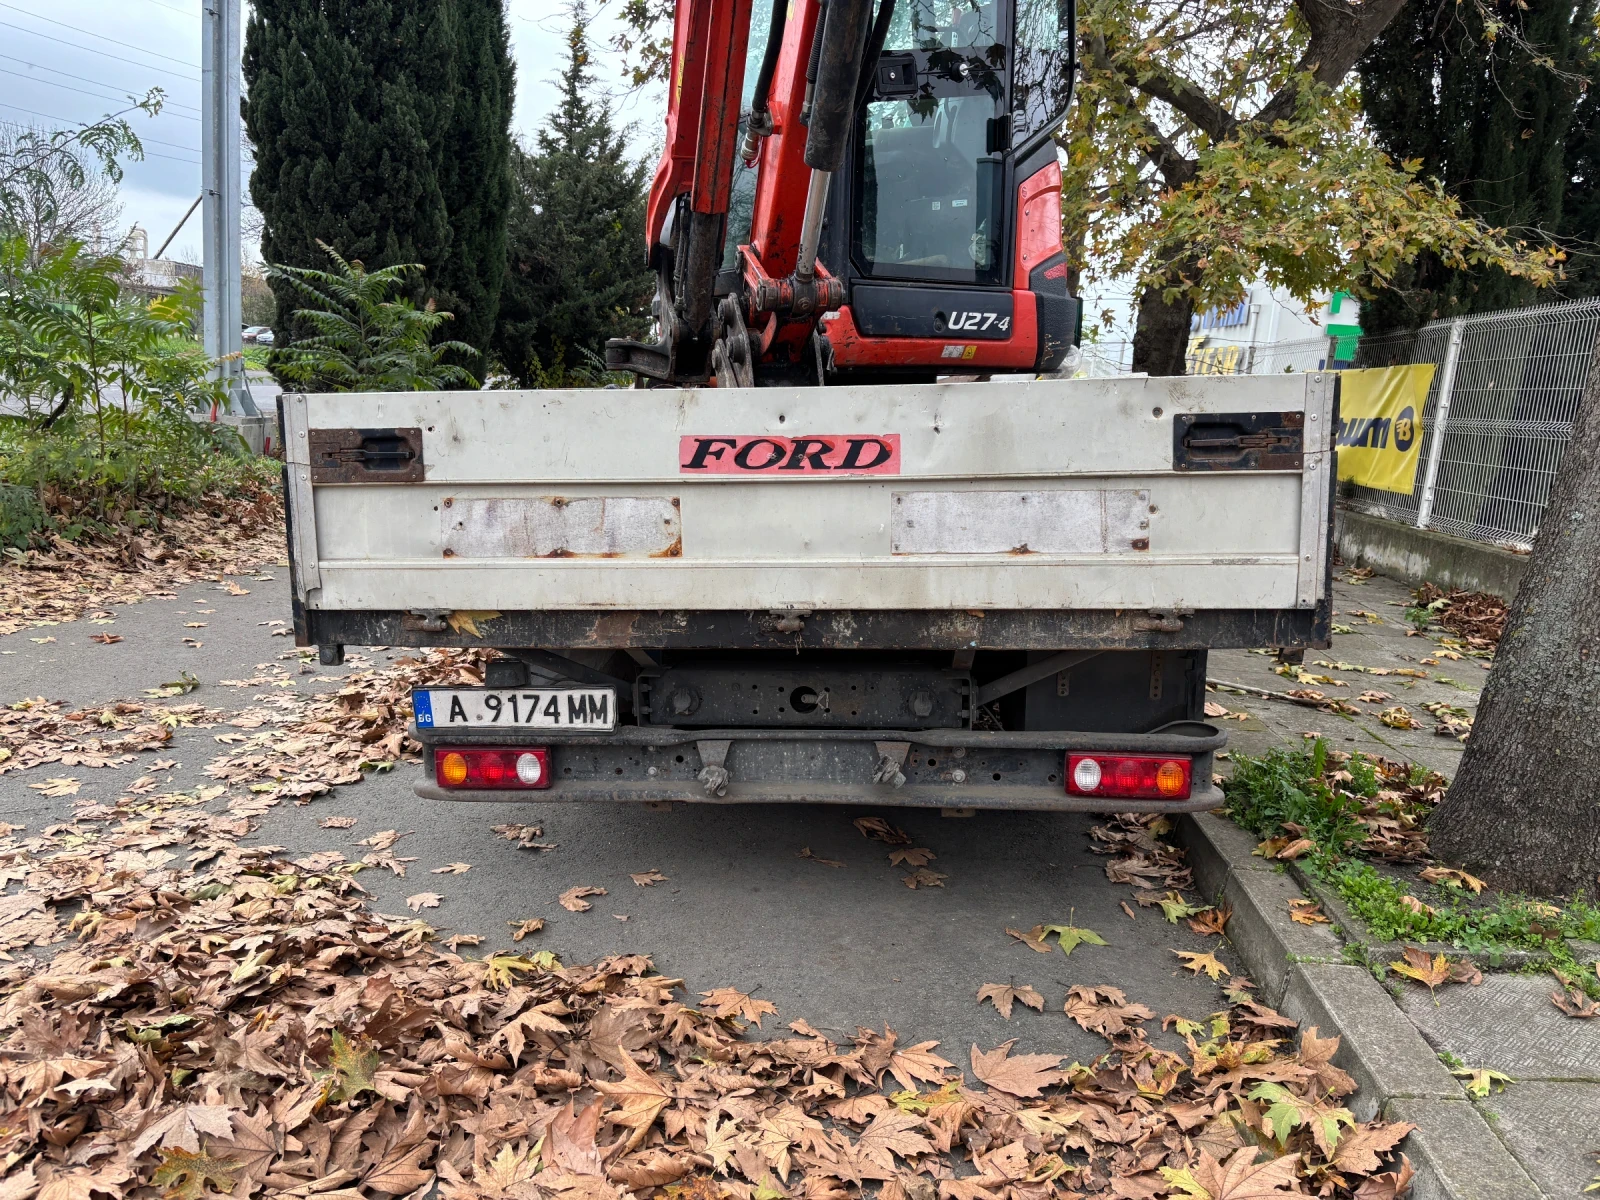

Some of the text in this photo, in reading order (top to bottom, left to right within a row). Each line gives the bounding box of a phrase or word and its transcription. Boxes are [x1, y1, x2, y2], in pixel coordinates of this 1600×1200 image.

[948, 311, 1010, 332] U27-4
[681, 438, 893, 470] FORD
[449, 694, 608, 725] A 9174 MM
